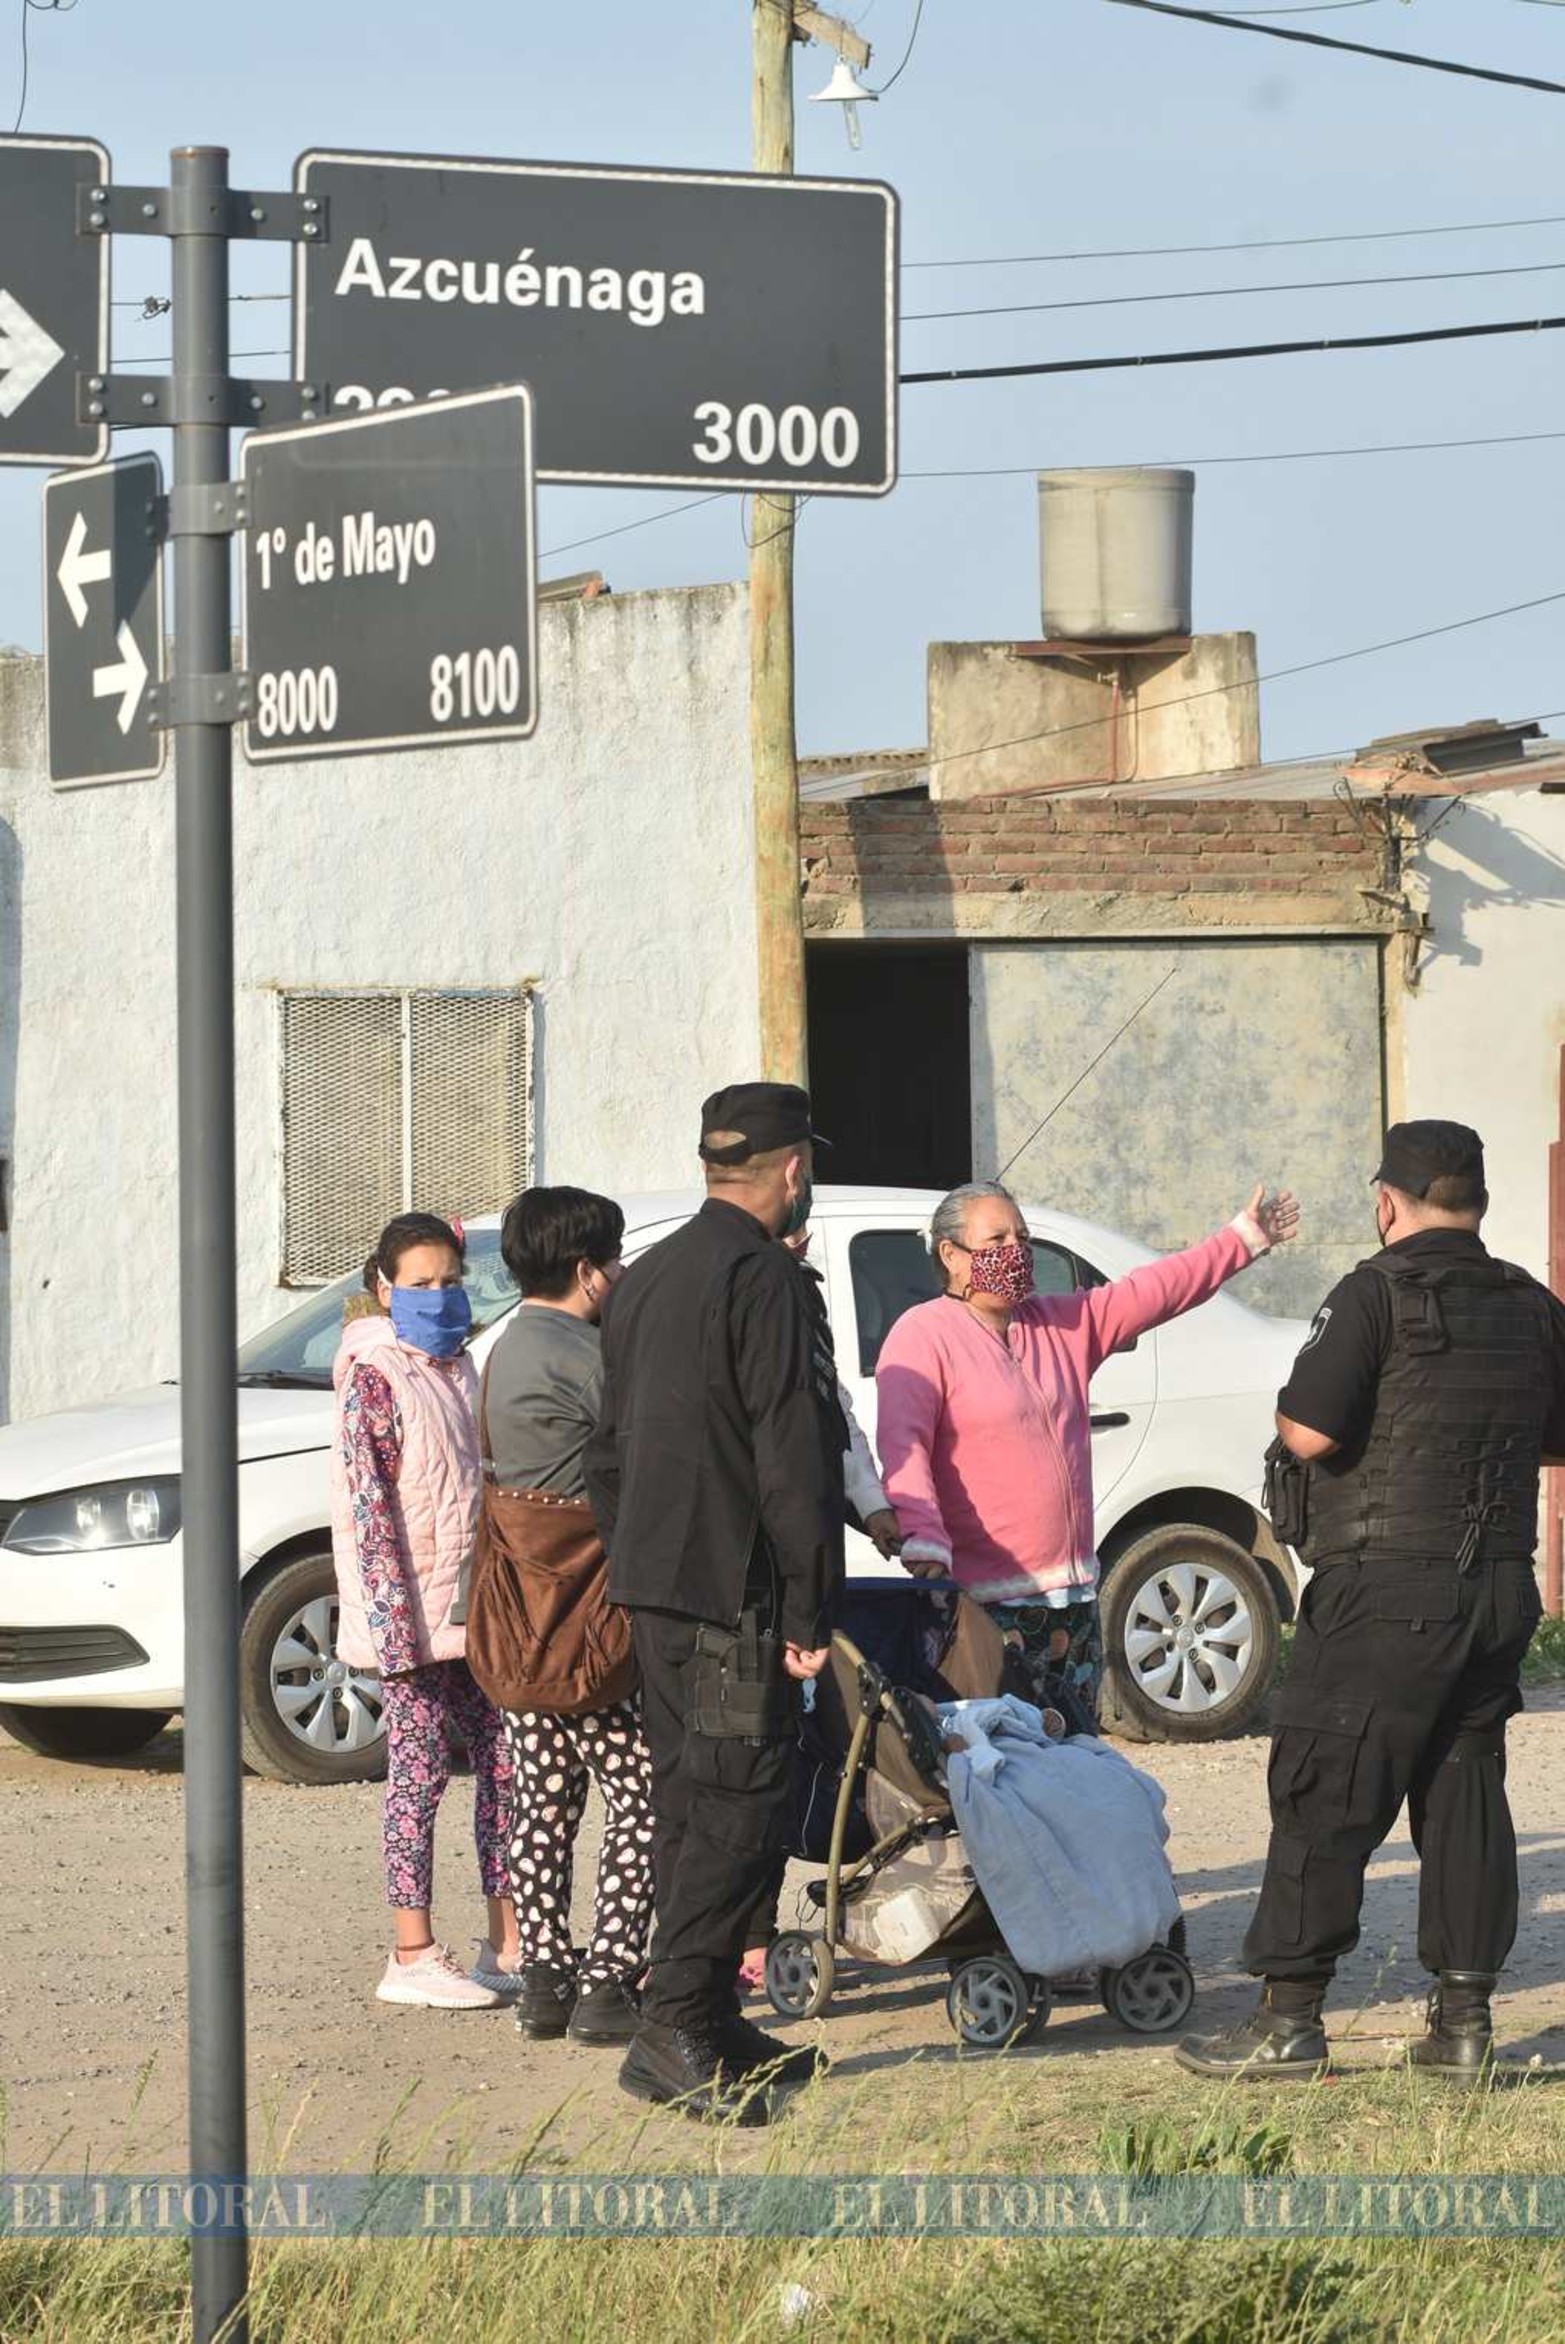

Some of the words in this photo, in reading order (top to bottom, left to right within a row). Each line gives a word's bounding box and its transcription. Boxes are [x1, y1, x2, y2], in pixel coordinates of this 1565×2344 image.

[333, 237, 706, 327] Azcuénaga
[692, 400, 861, 469] 3000
[293, 521, 336, 585] de
[341, 511, 437, 585] Mayo
[256, 664, 339, 738] 8000
[429, 644, 521, 723] 8100
